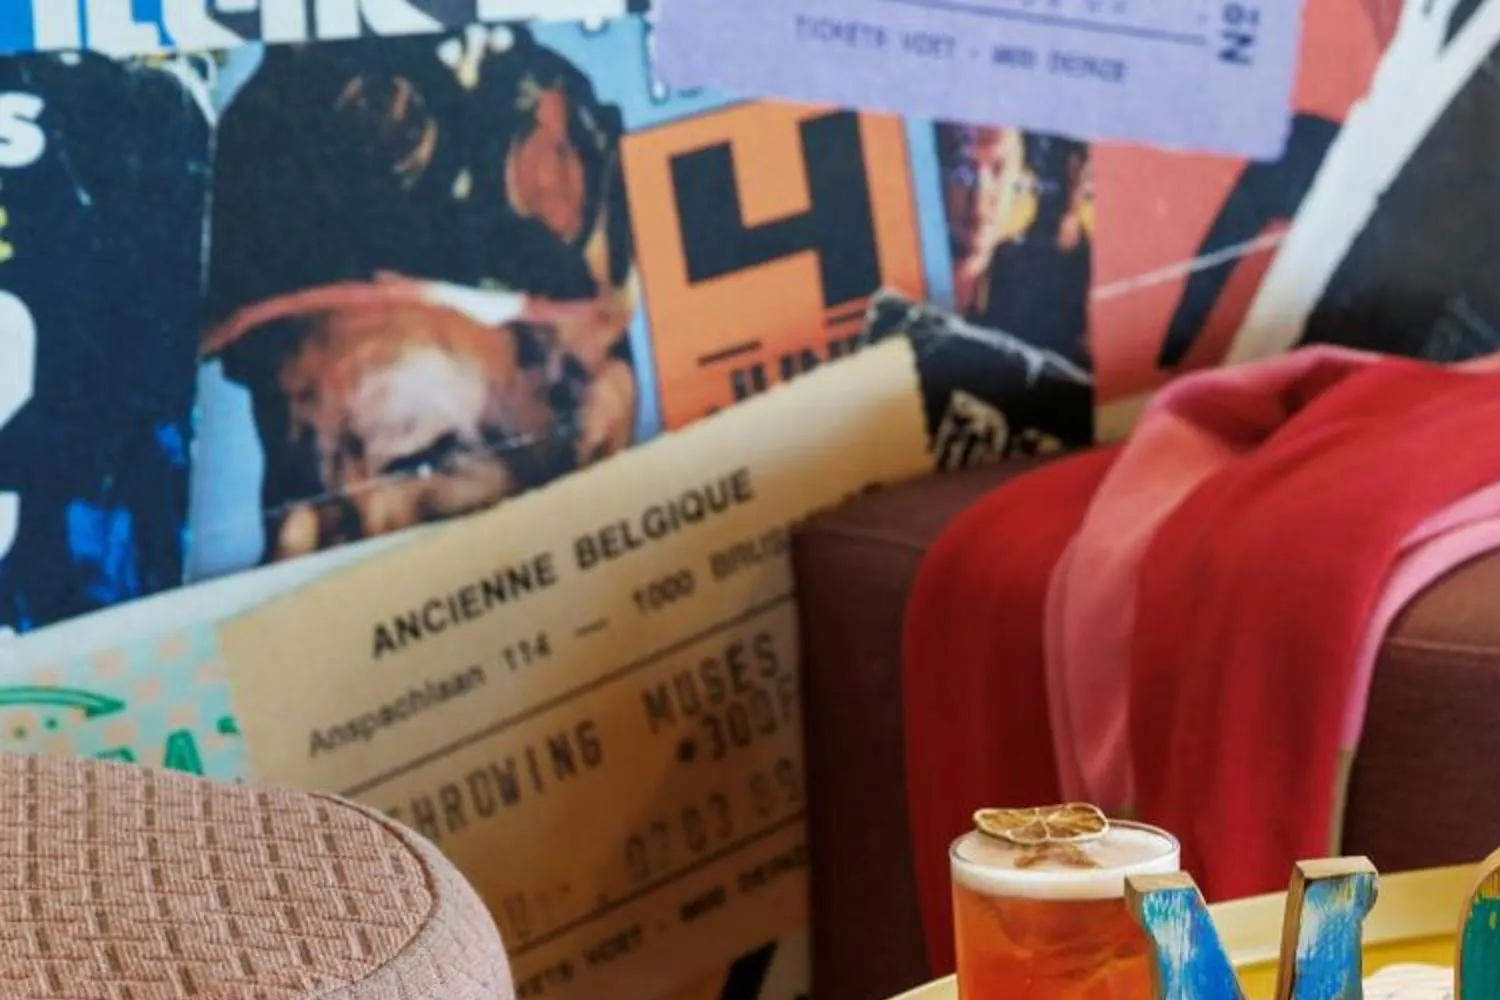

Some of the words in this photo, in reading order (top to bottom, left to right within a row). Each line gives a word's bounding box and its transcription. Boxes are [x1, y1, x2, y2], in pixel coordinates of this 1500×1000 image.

[371, 551, 560, 660] ANCIENNE
[572, 465, 757, 572] BELGIQUE
[308, 664, 487, 758] Anspachlaan
[632, 568, 697, 614] 1000
[641, 632, 780, 735] MUSES
